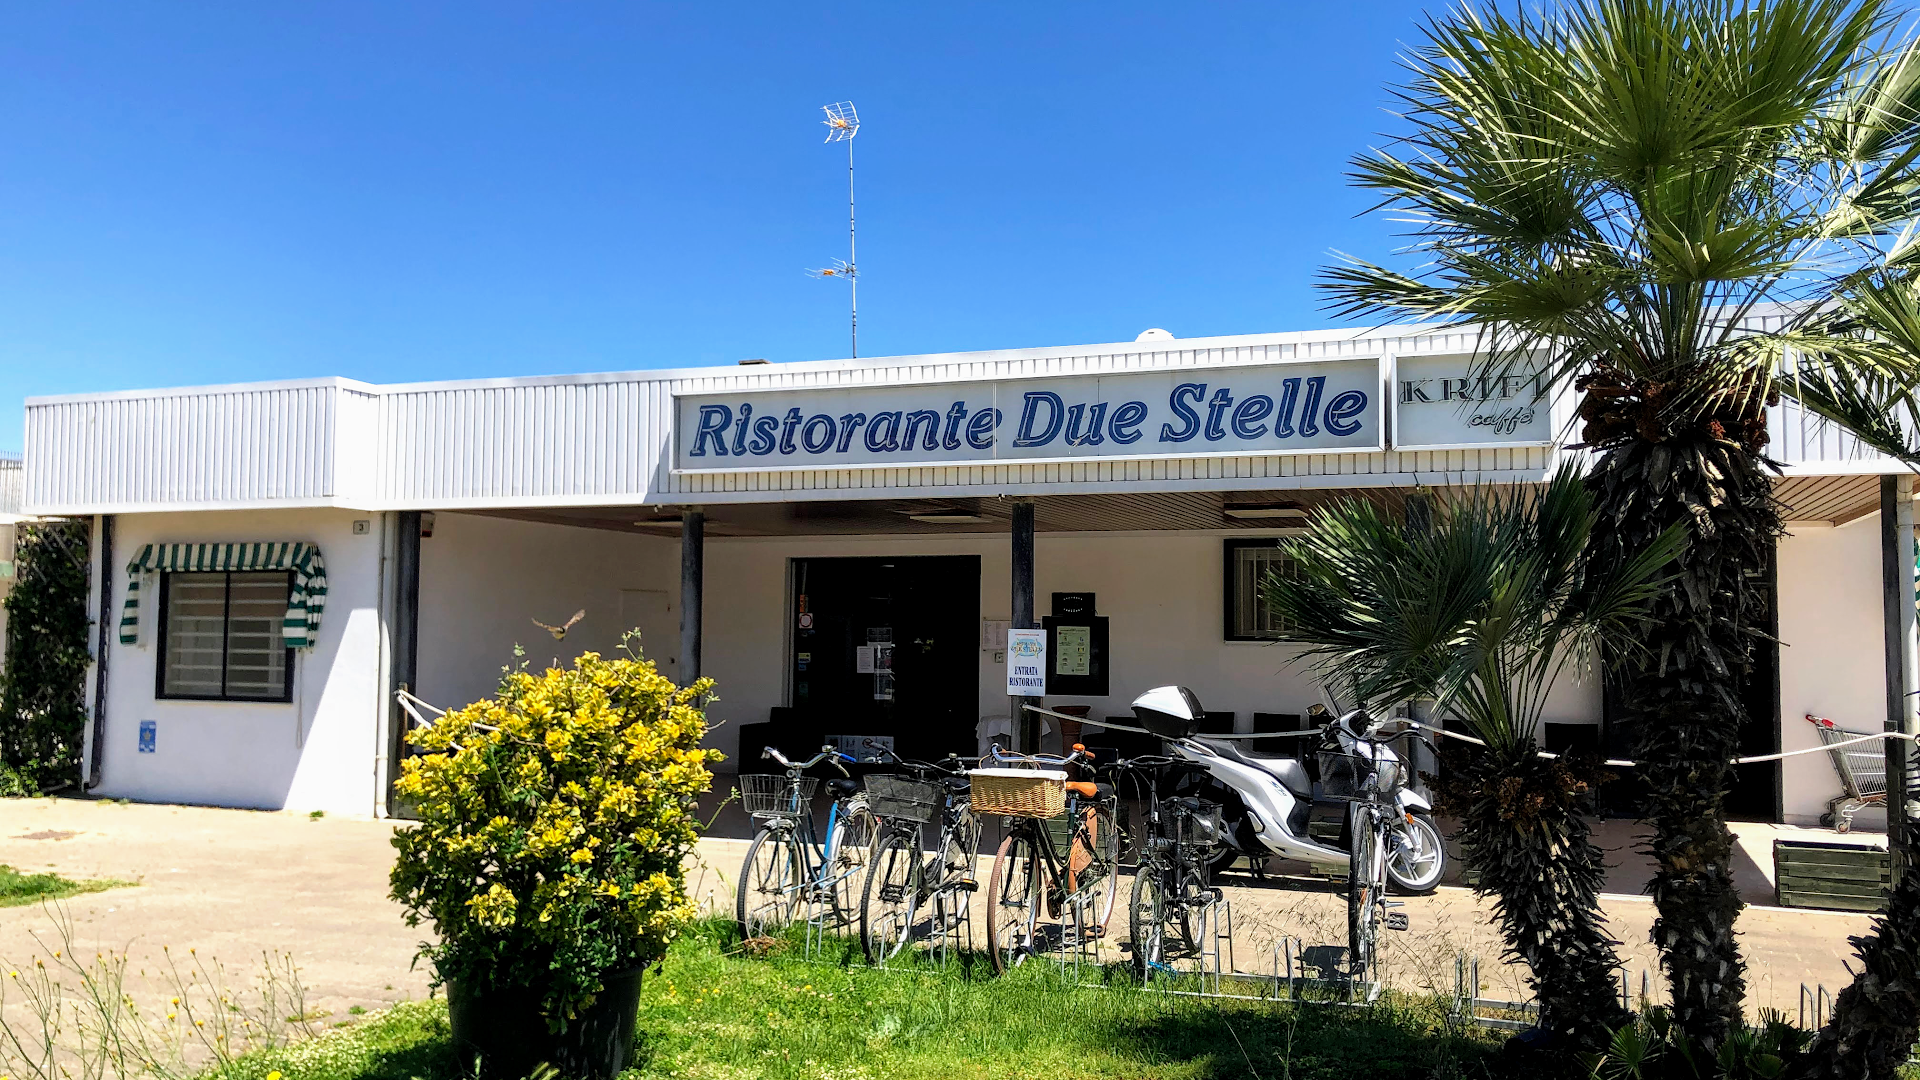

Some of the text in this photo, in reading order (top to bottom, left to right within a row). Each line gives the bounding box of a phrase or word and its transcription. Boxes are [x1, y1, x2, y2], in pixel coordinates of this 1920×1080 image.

[1400, 373, 1549, 405] KRIFI
[689, 375, 1369, 457] Ristorante Due Stelle
[1014, 666, 1038, 676] ENTRATA
[1009, 677, 1044, 687] RISTORANTE
